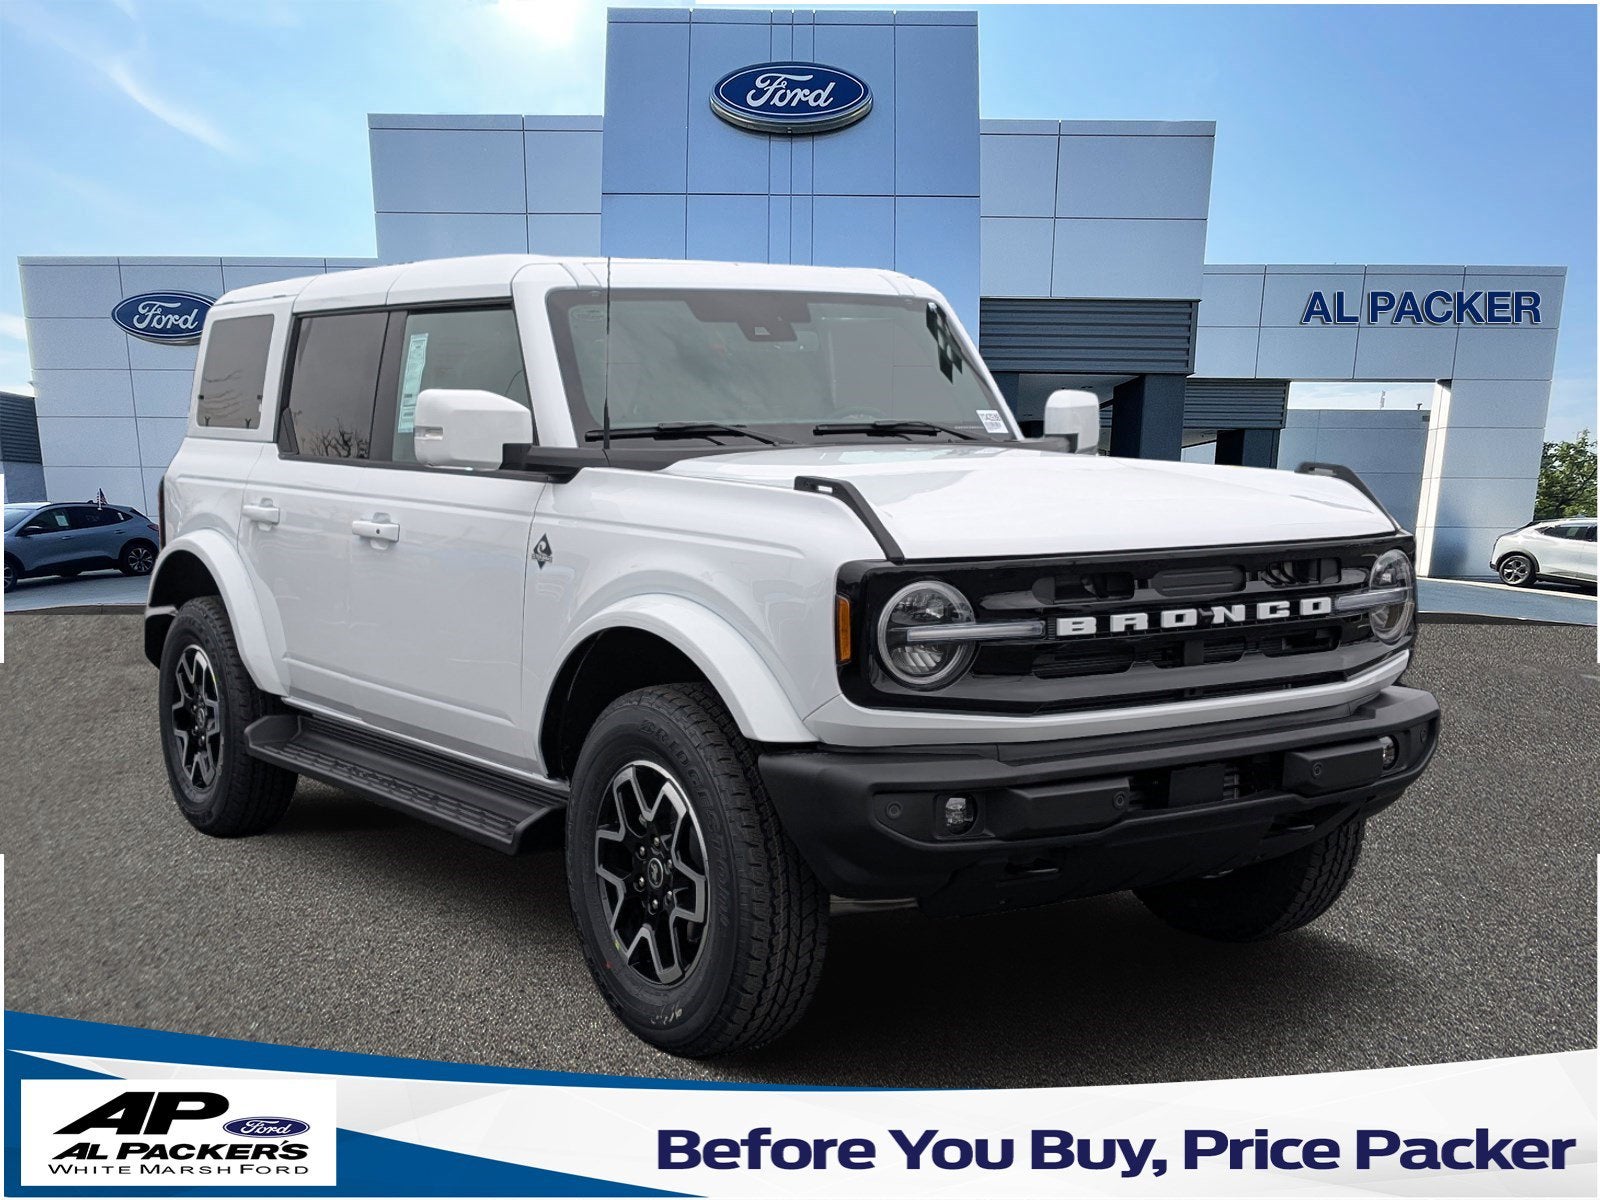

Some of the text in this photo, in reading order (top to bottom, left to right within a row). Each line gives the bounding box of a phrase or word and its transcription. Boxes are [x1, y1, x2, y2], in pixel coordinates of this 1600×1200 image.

[746, 73, 836, 108] Ford
[132, 301, 199, 330] Ford
[1301, 289, 1542, 325] AL PACKER
[1056, 597, 1332, 637] BRONCO
